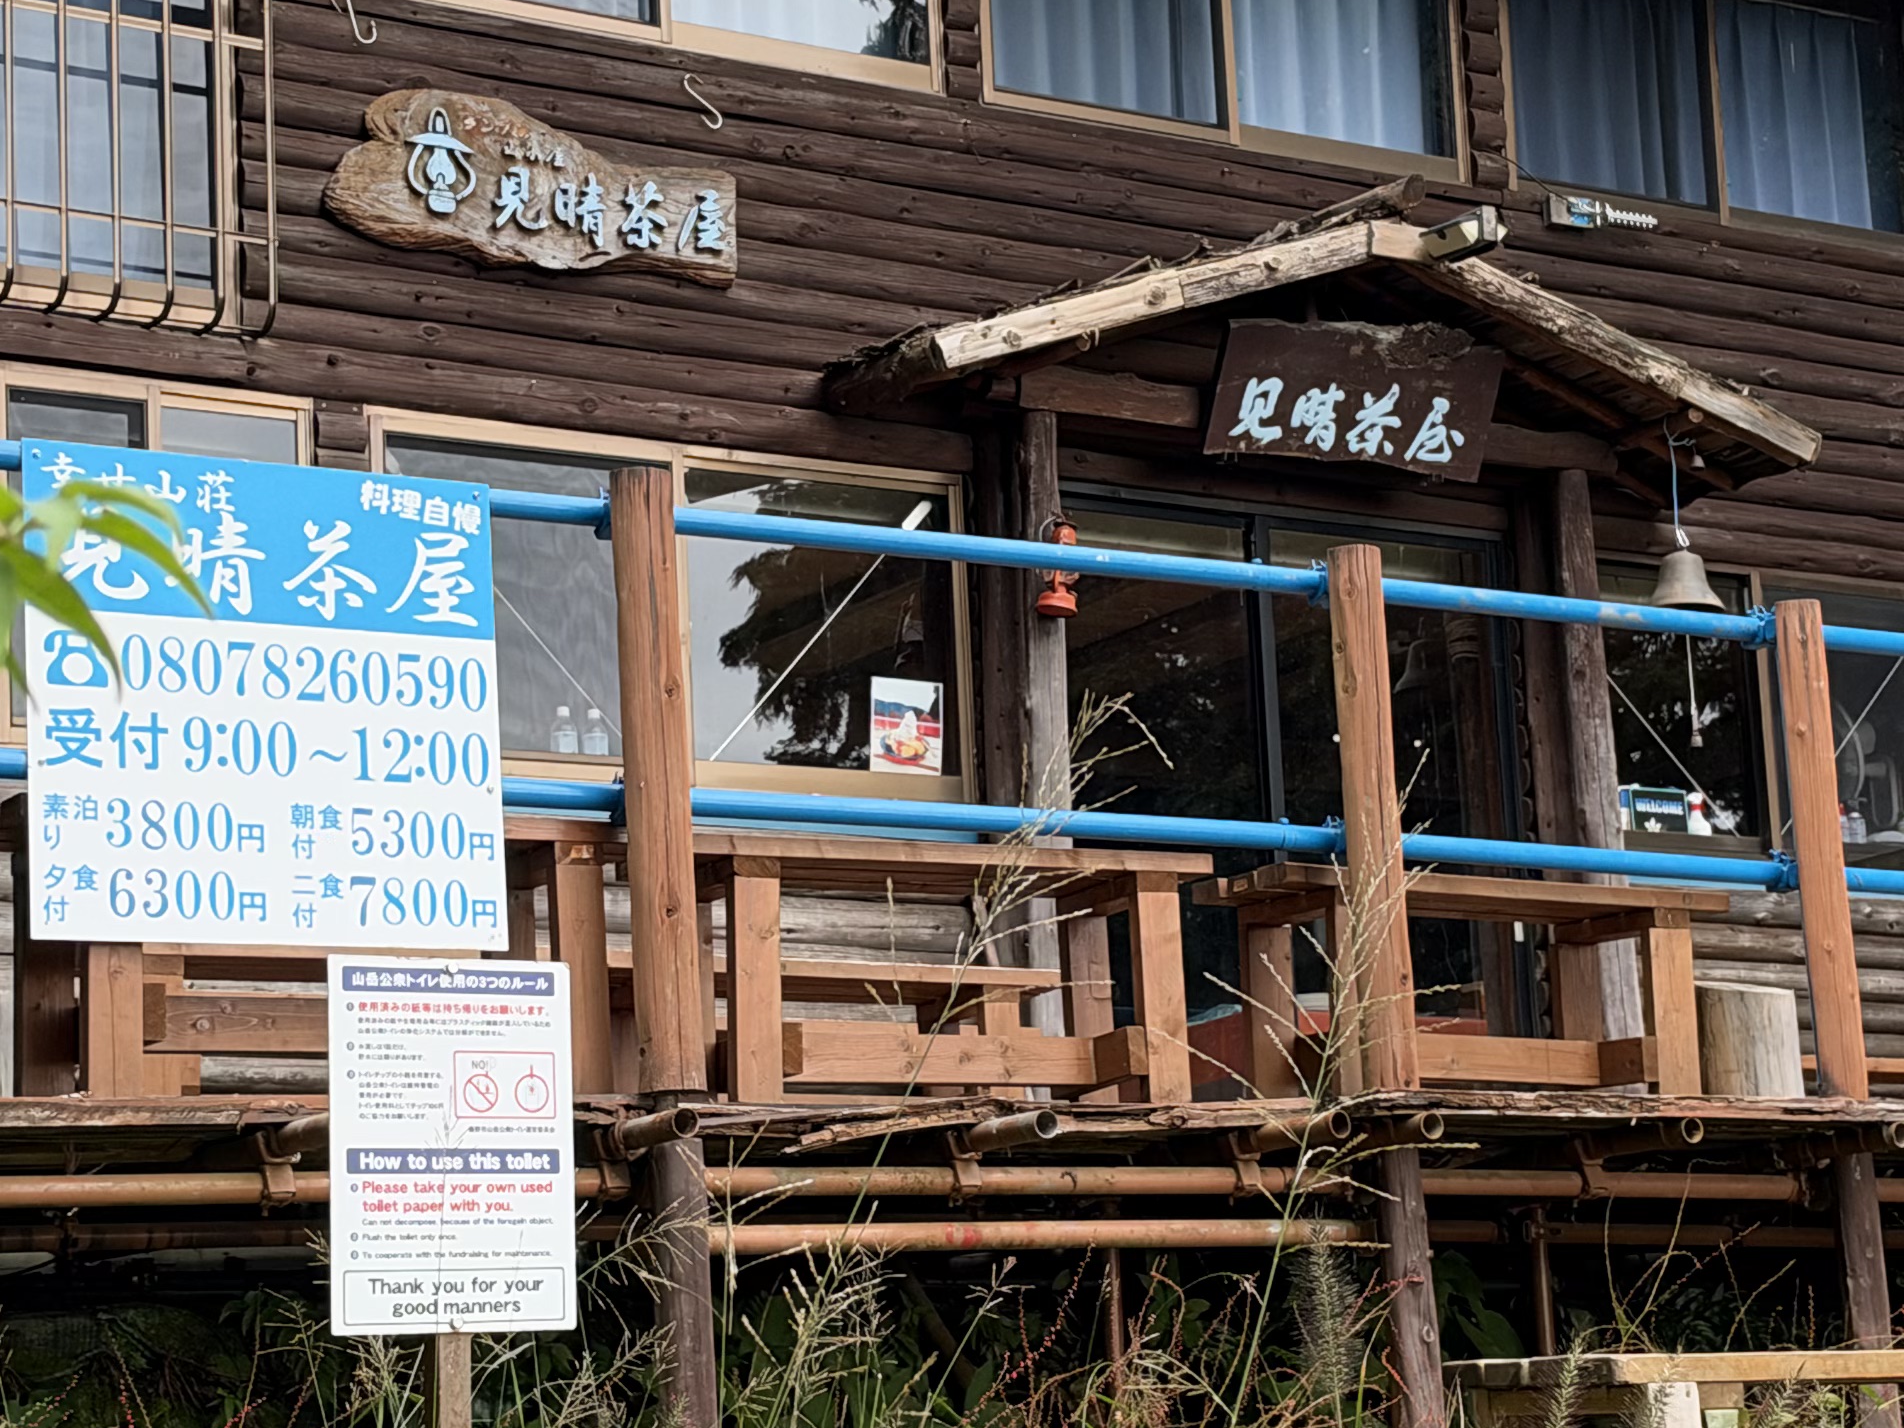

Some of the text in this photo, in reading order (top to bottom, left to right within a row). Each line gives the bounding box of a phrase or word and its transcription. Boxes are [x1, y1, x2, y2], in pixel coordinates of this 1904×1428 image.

[495, 166, 733, 251] 見晴茶屋
[1228, 376, 1465, 463] 見晴茶屋
[359, 480, 481, 537] 料理自慢
[121, 632, 488, 713] 08078260590
[43, 705, 170, 772] 受付
[1634, 797, 1685, 816] WELCOME
[359, 1151, 551, 1170] How to use this toilet
[362, 1180, 553, 1195] Please take your own used
[362, 1199, 514, 1214] toilet paper with you.
[384, 1233, 396, 1241] the
[368, 1277, 544, 1296] Thank you for your
[392, 1298, 521, 1318] good manners
